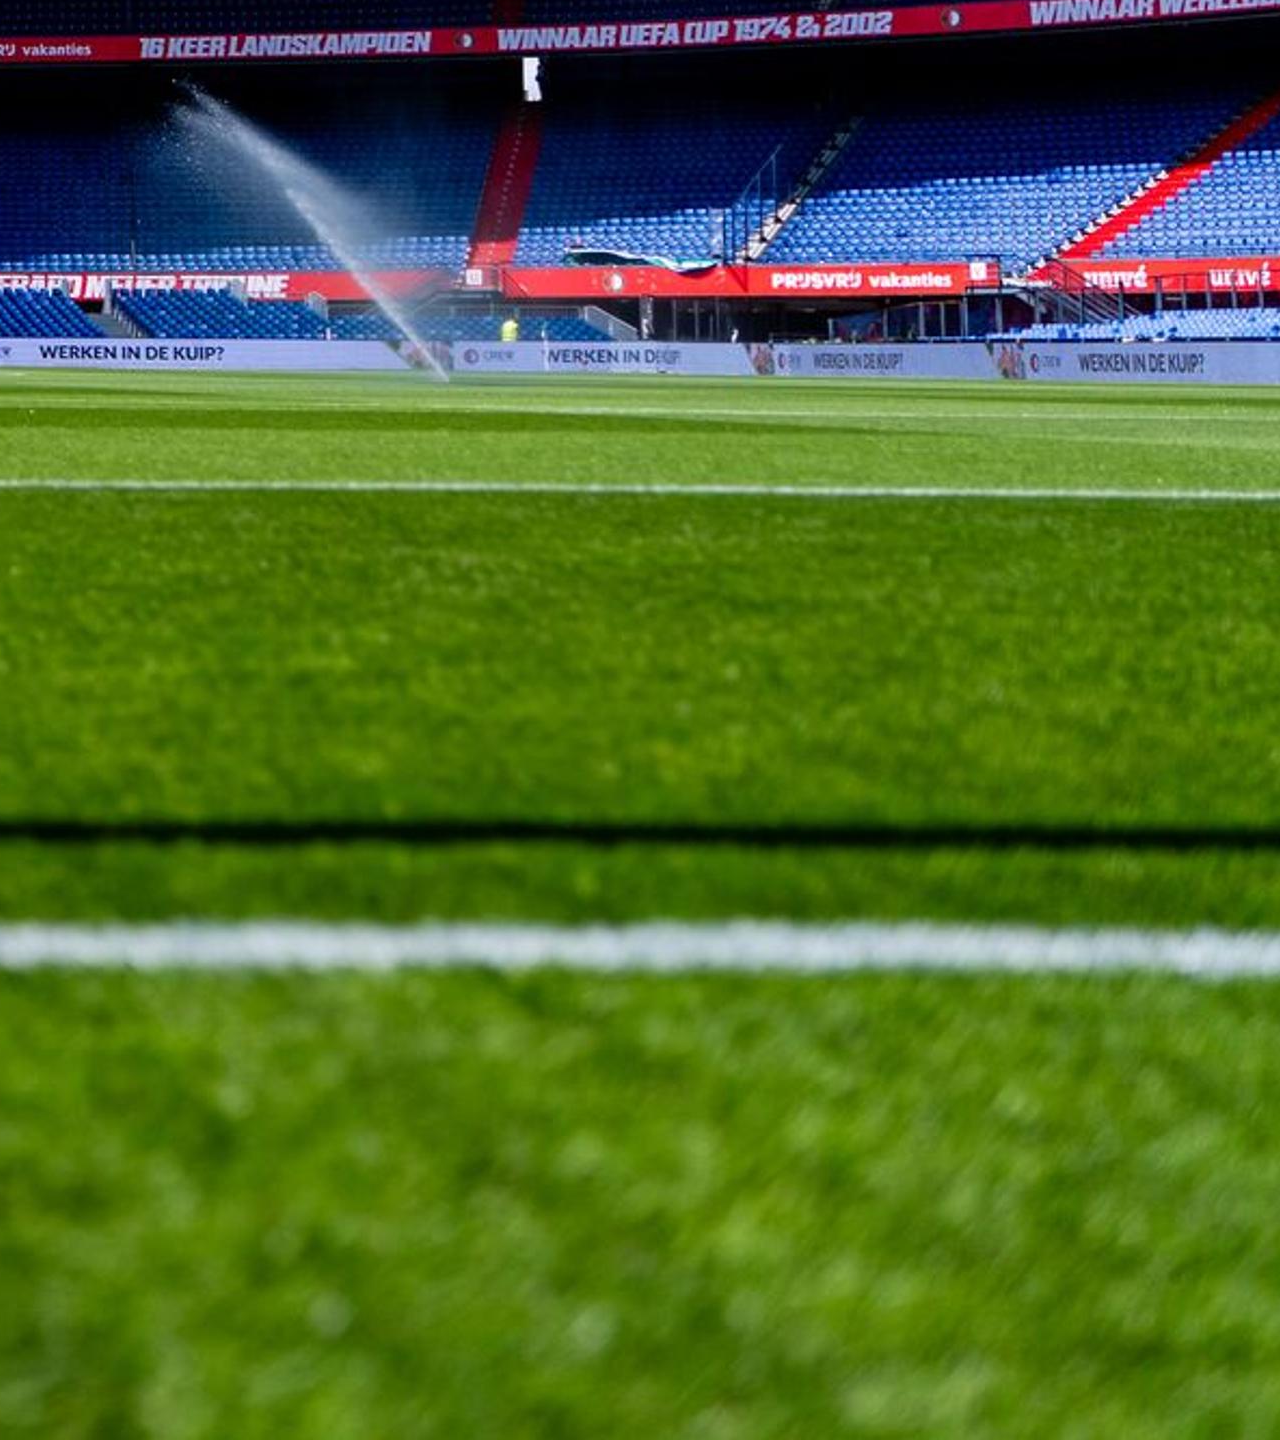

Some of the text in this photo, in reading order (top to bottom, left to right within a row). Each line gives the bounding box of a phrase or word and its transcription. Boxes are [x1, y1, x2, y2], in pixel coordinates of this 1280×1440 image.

[497, 24, 617, 51] WINNAAR
[618, 21, 681, 47] UEFA
[682, 22, 730, 46] CUP
[733, 19, 792, 43] 1974
[822, 14, 893, 39] 2002
[22, 43, 92, 57] vakanties
[140, 30, 432, 59] 16 KEER LANDSKAMPIOEN
[869, 271, 953, 291] vakanties
[40, 345, 225, 361] WERKEN IN DE KUIP?
[623, 349, 640, 364] IN
[1077, 353, 1205, 374] WERKEN IN DE KUIP?
